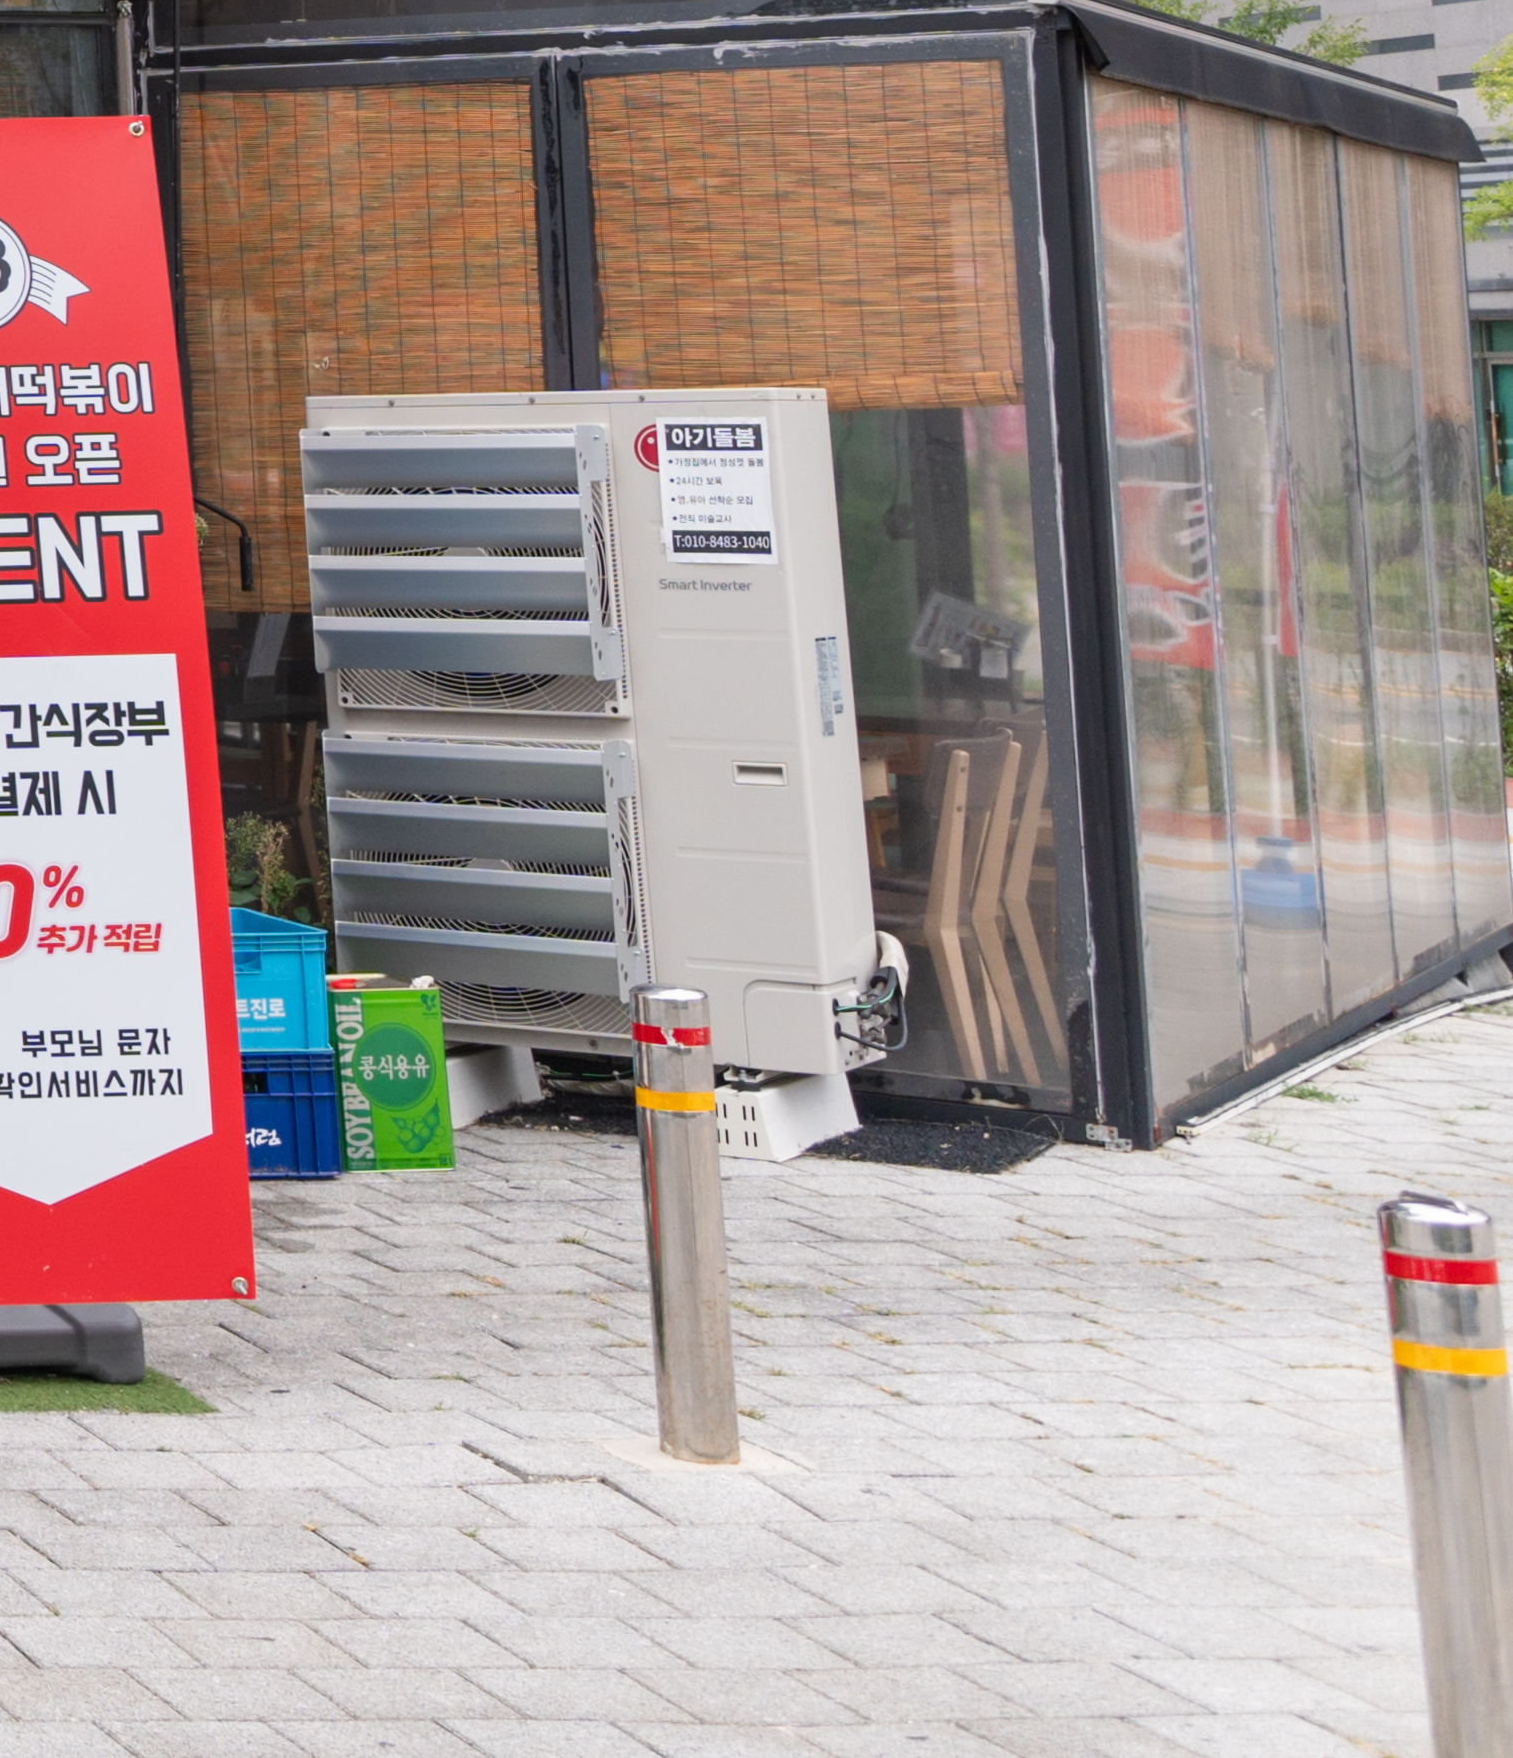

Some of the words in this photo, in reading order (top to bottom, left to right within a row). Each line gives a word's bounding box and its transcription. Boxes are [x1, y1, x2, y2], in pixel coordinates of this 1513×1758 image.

[670, 426, 756, 448] 아기돌봄
[24, 431, 122, 487] 오픈
[675, 476, 703, 486] 24시간
[736, 495, 753, 505] 모집
[679, 514, 696, 523] 전직
[658, 579, 699, 591] Smart
[700, 580, 752, 592] Inverter
[77, 769, 118, 817] 시
[36, 922, 99, 955] 추가
[102, 921, 164, 954] 적립
[334, 996, 365, 1041] OIL
[20, 1029, 104, 1058] 부모님
[117, 1028, 171, 1056] 문자
[358, 1054, 430, 1081] 콩식용유
